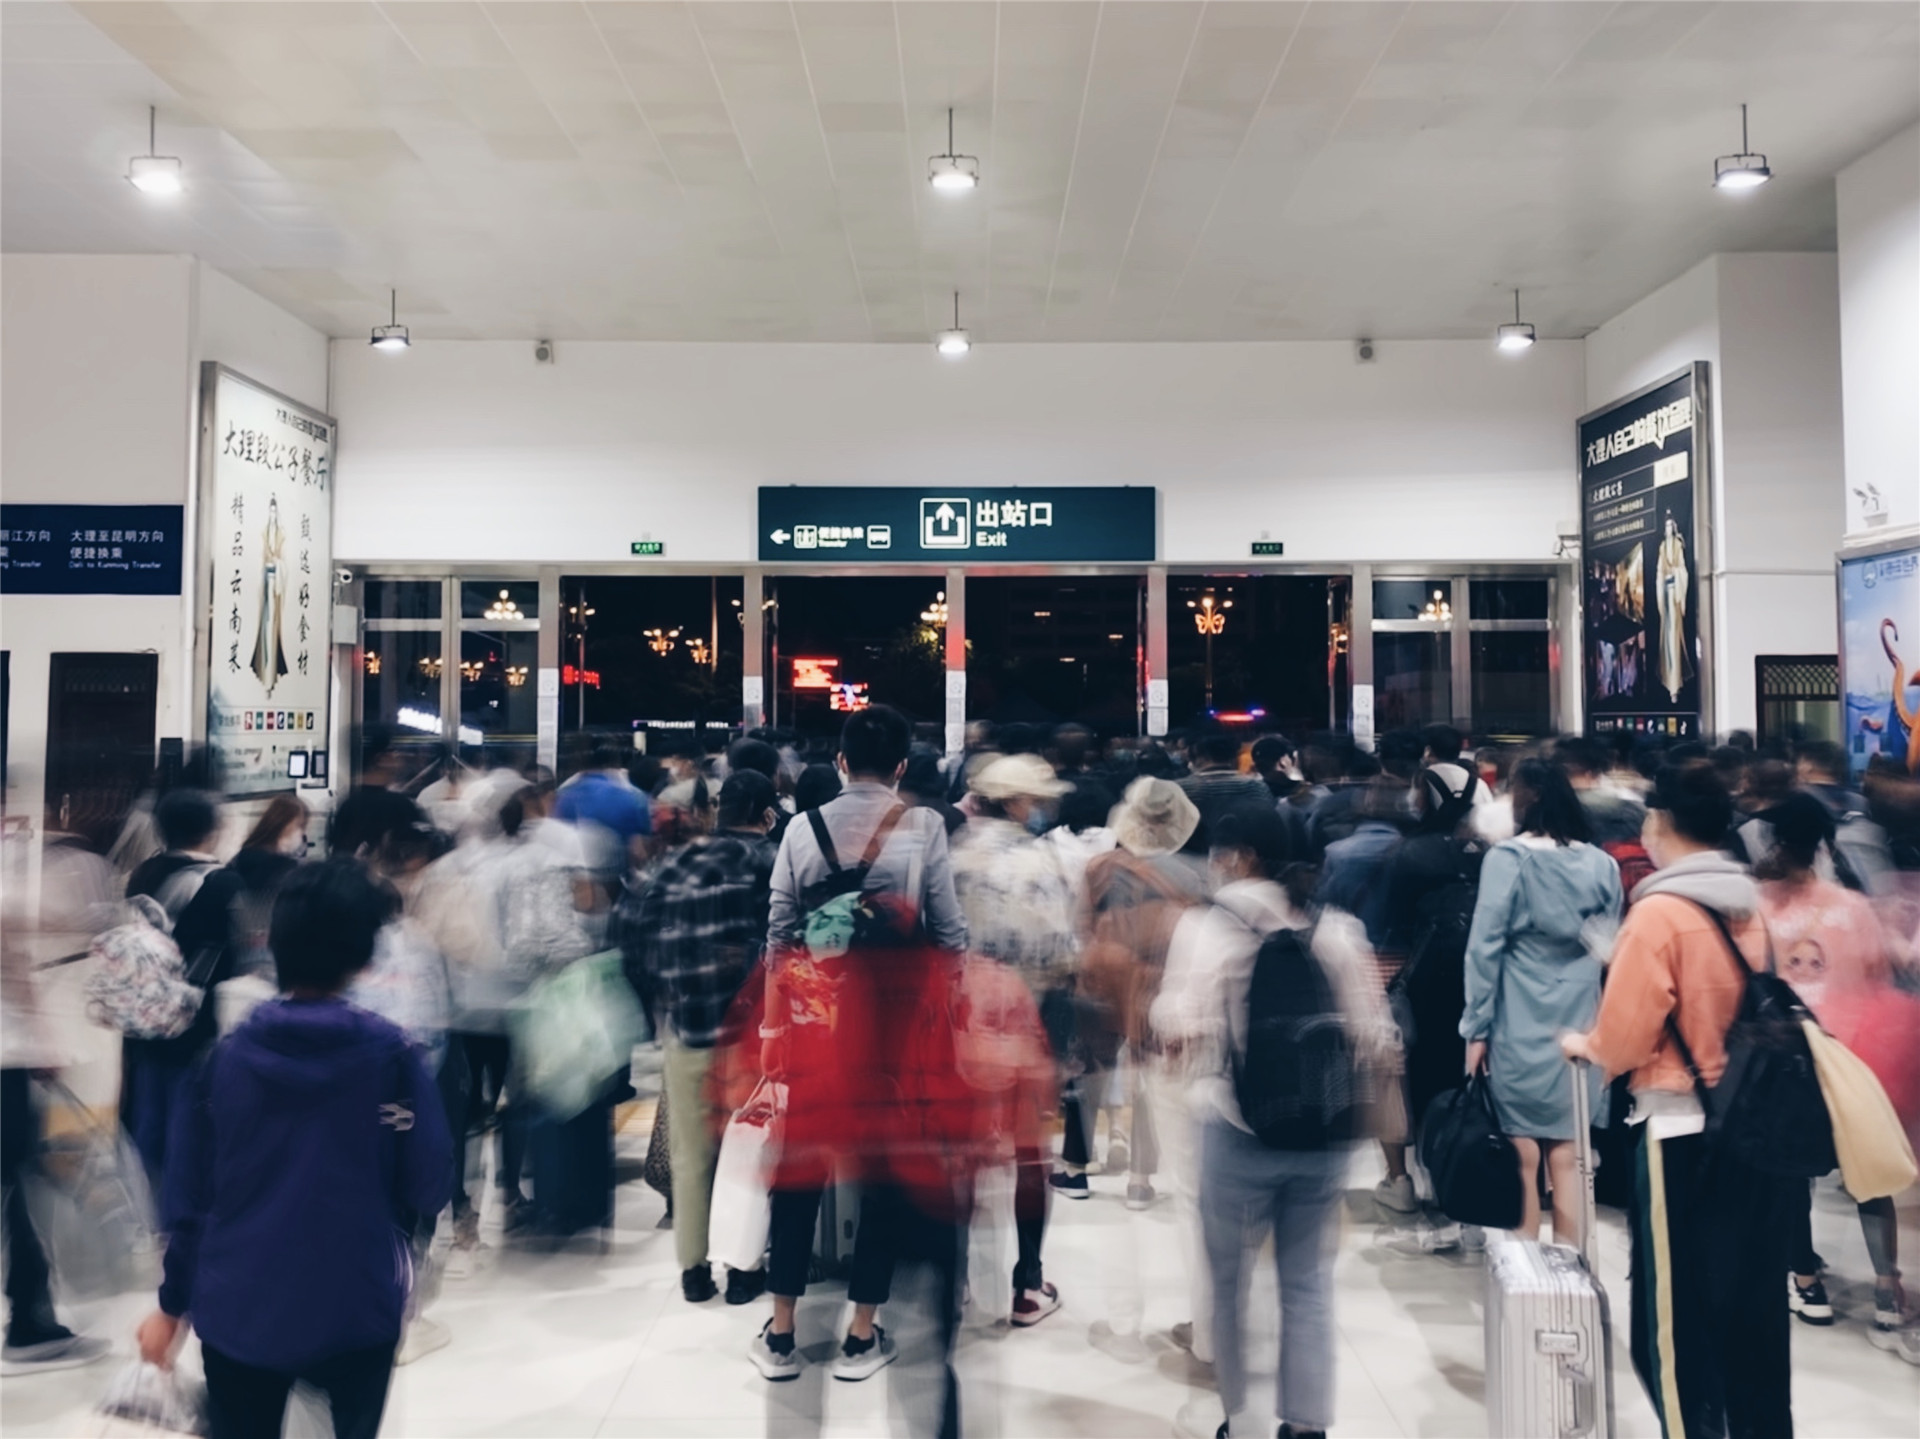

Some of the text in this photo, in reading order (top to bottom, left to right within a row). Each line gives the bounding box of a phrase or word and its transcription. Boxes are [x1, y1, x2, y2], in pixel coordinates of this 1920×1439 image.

[976, 500, 1052, 528] 出站口
[70, 530, 164, 542] 大理至昆明方向
[976, 531, 1007, 546] Exit
[70, 547, 122, 559] 便捷换乘
